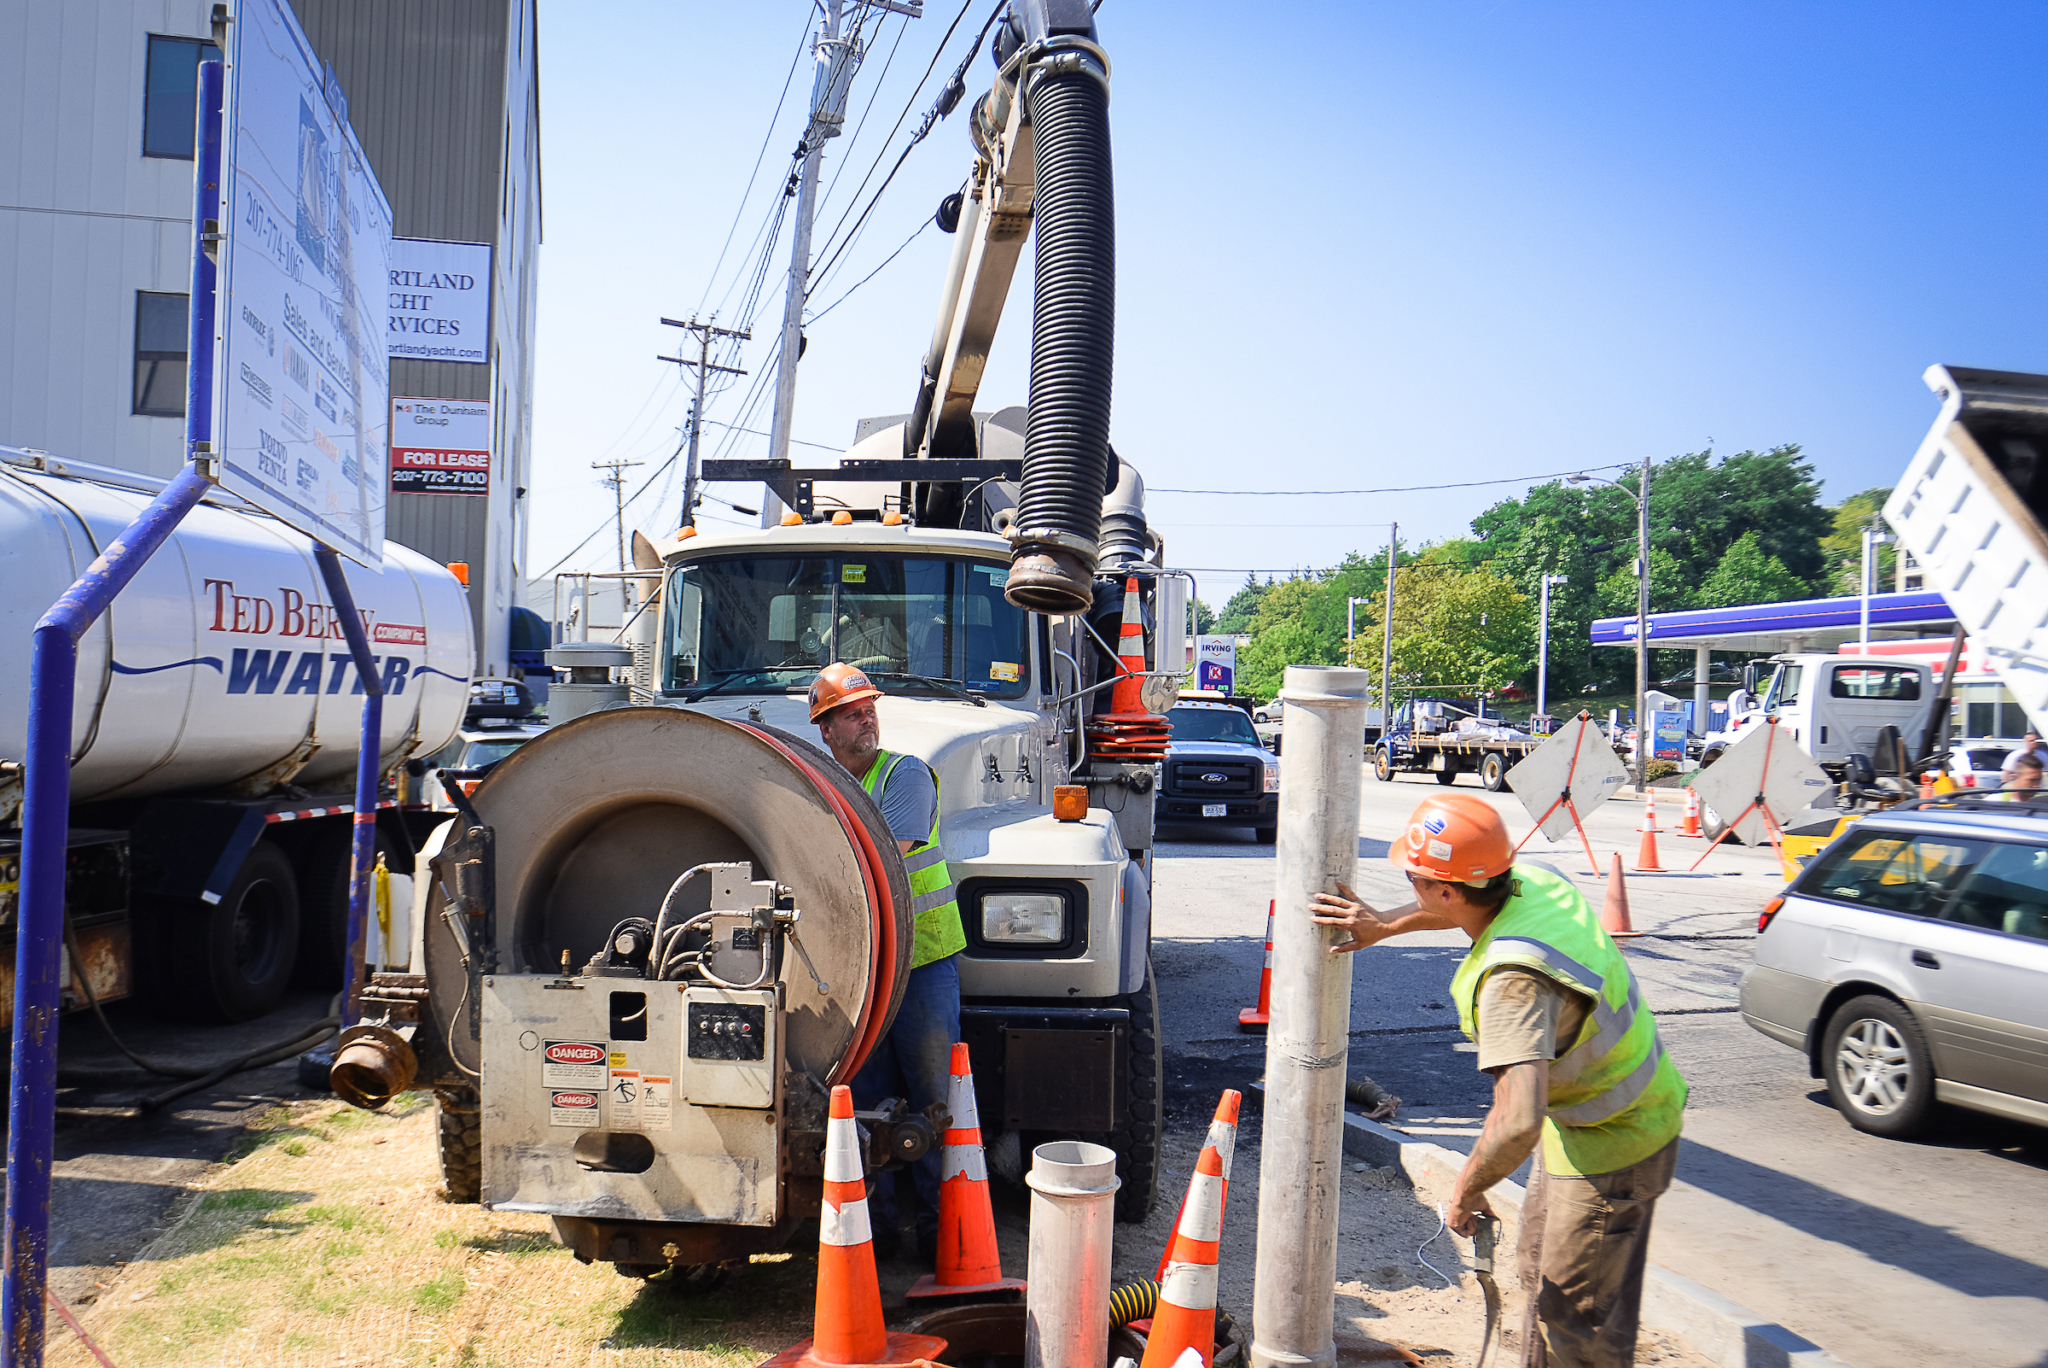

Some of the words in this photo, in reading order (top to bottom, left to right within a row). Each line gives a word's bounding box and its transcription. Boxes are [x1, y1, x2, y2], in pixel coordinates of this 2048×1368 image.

[246, 191, 304, 286] 207-774-1067
[390, 270, 474, 290] RTLAND
[389, 293, 432, 310] CHT
[389, 316, 460, 335] RVICES
[284, 293, 307, 339] Sales
[311, 329, 324, 357] and
[327, 342, 350, 387] Service
[388, 344, 483, 358] ortlandyacht.com
[414, 404, 436, 413] The
[441, 405, 487, 415] Dunham
[414, 415, 449, 426] Group
[260, 429, 287, 464] VOLVO
[403, 452, 436, 464] FOR
[439, 453, 488, 467] LEASE
[259, 451, 287, 486] PENTA
[393, 470, 487, 484] 207-773-7100
[205, 578, 274, 634] TED
[279, 587, 375, 642] BERY
[1624, 622, 1653, 635] IRVG
[1202, 644, 1231, 652] IRVING
[552, 1048, 598, 1059] DANGER
[557, 1096, 592, 1105] DANGER
